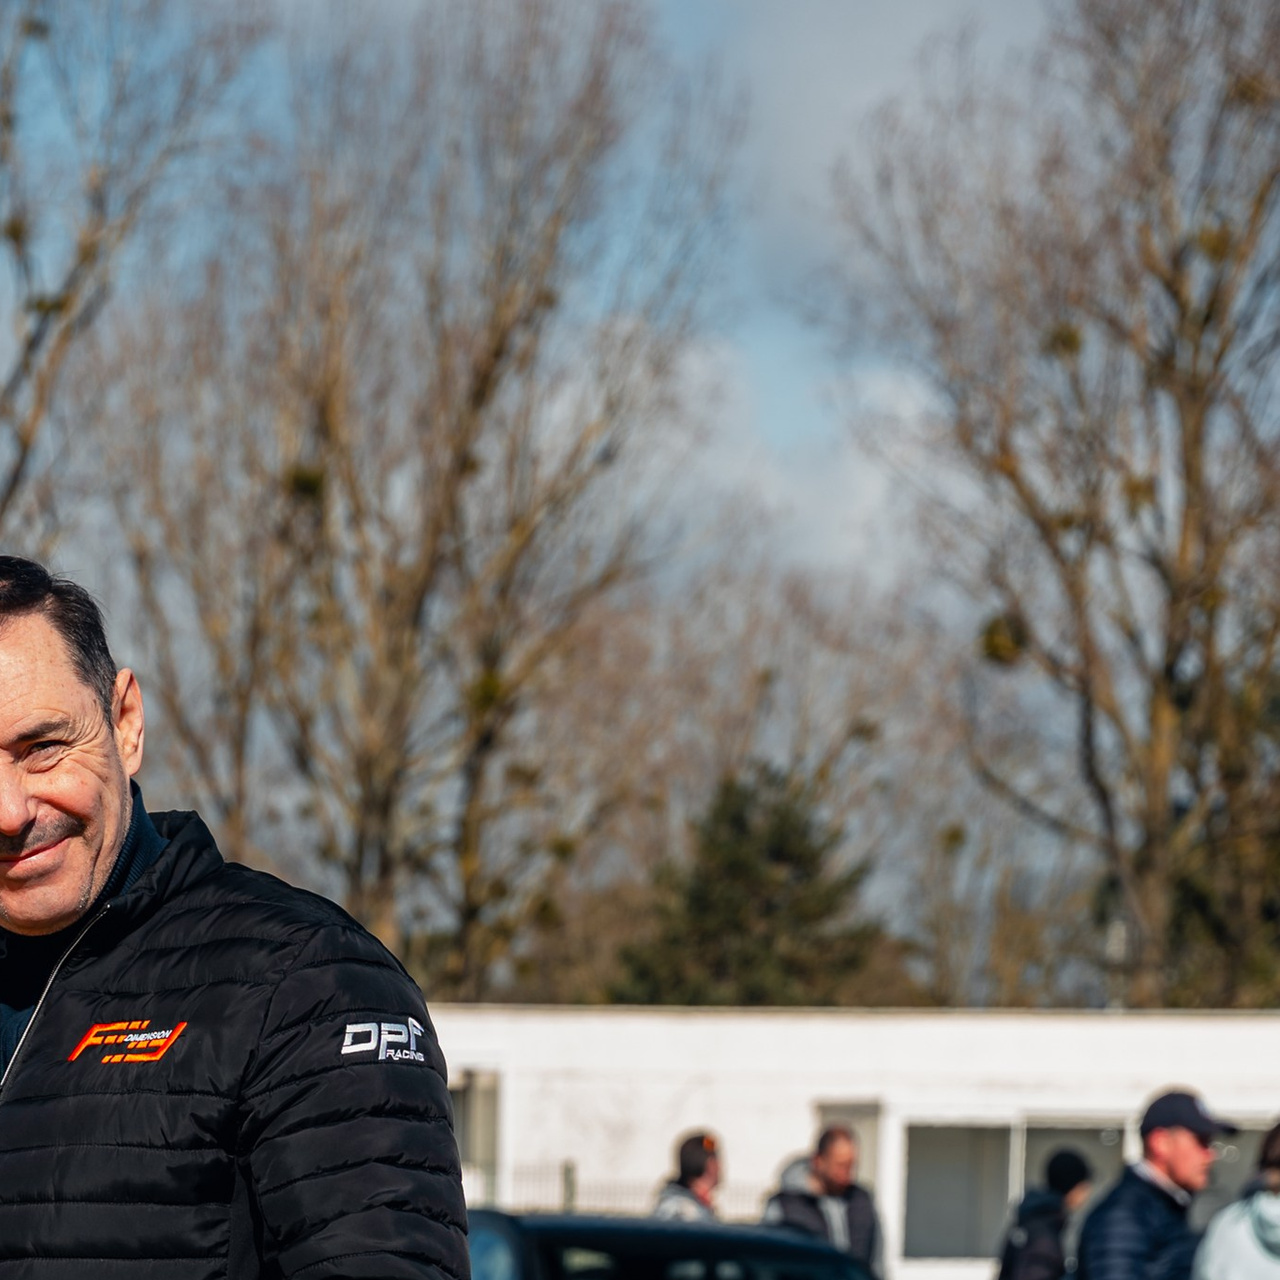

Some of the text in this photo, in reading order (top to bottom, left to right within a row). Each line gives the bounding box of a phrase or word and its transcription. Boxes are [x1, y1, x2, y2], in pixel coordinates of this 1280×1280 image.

[123, 1029, 172, 1042] DIMENSION
[341, 1017, 424, 1060] DPF
[386, 1049, 425, 1061] RACING
